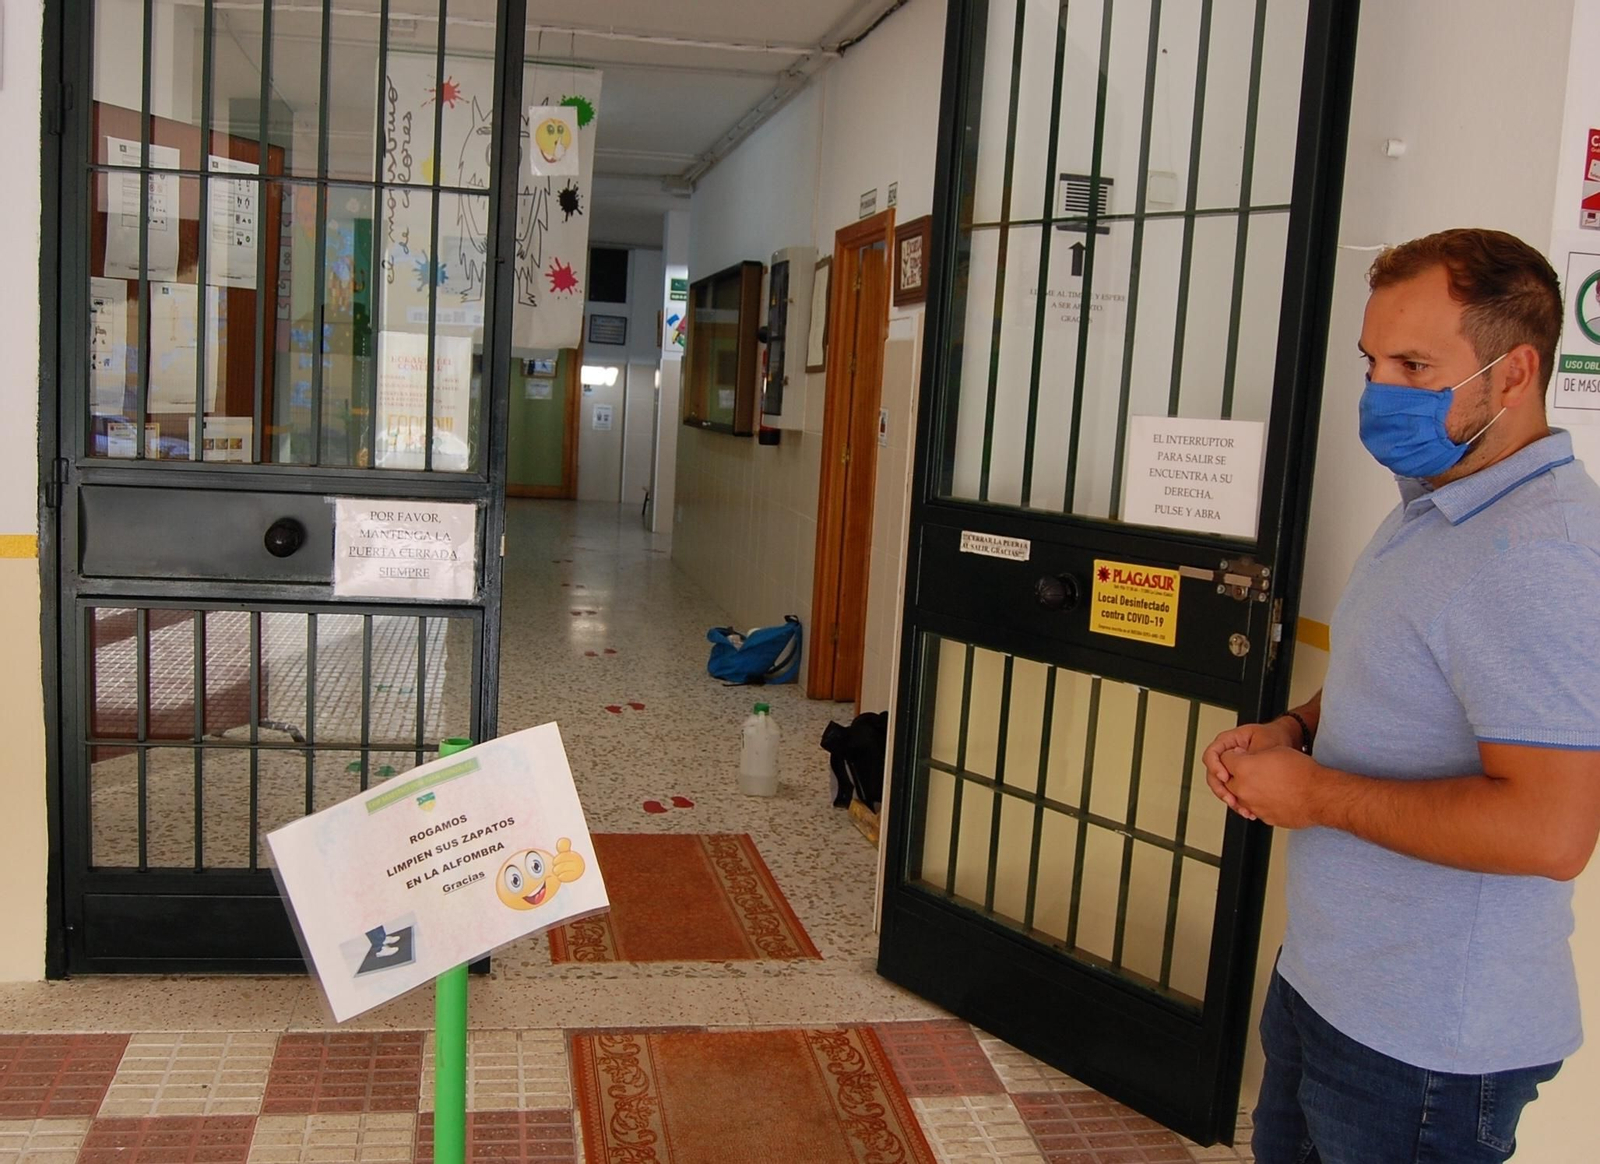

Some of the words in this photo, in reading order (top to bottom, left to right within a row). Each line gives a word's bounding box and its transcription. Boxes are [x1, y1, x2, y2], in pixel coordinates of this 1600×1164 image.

[399, 227, 410, 254] de
[1565, 360, 1583, 369] USO
[1563, 377, 1576, 392] DE
[1153, 434, 1164, 444] EL
[1166, 435, 1235, 448] INTERRUPTOR
[1157, 451, 1183, 462] PARA
[1185, 453, 1214, 465] SALIR
[1215, 455, 1227, 466] SE
[1149, 468, 1209, 482] ENCUENTRA
[1210, 473, 1218, 483] A
[1219, 473, 1233, 484] SU
[1164, 486, 1214, 500] DERECHA.
[370, 511, 394, 522] POR
[397, 512, 442, 524] FAVOR,
[1154, 504, 1184, 516] PULSE
[1185, 507, 1193, 517] Y
[1194, 509, 1221, 520] ABRA
[359, 529, 432, 540] MANTENGA
[435, 531, 451, 541] LA
[1003, 539, 1028, 549] PUERTA
[349, 546, 397, 557] PUERTA
[399, 549, 458, 561] CERRADA
[379, 567, 430, 578] SIEMPRE
[1113, 569, 1174, 591] PLAGASUR
[1097, 592, 1118, 605] Local
[1120, 595, 1170, 613] Desinfectado
[1101, 609, 1125, 621] contra
[1127, 611, 1164, 628] COVID-19
[409, 814, 468, 844] ROGAMOS
[386, 849, 433, 878] LIMPIEN
[435, 838, 459, 854] SUS
[461, 817, 515, 844] ZAPATOS
[405, 875, 422, 890] EN
[424, 867, 440, 881] LA
[442, 842, 505, 873] ALFOMBRA
[442, 871, 486, 894] Gracias
